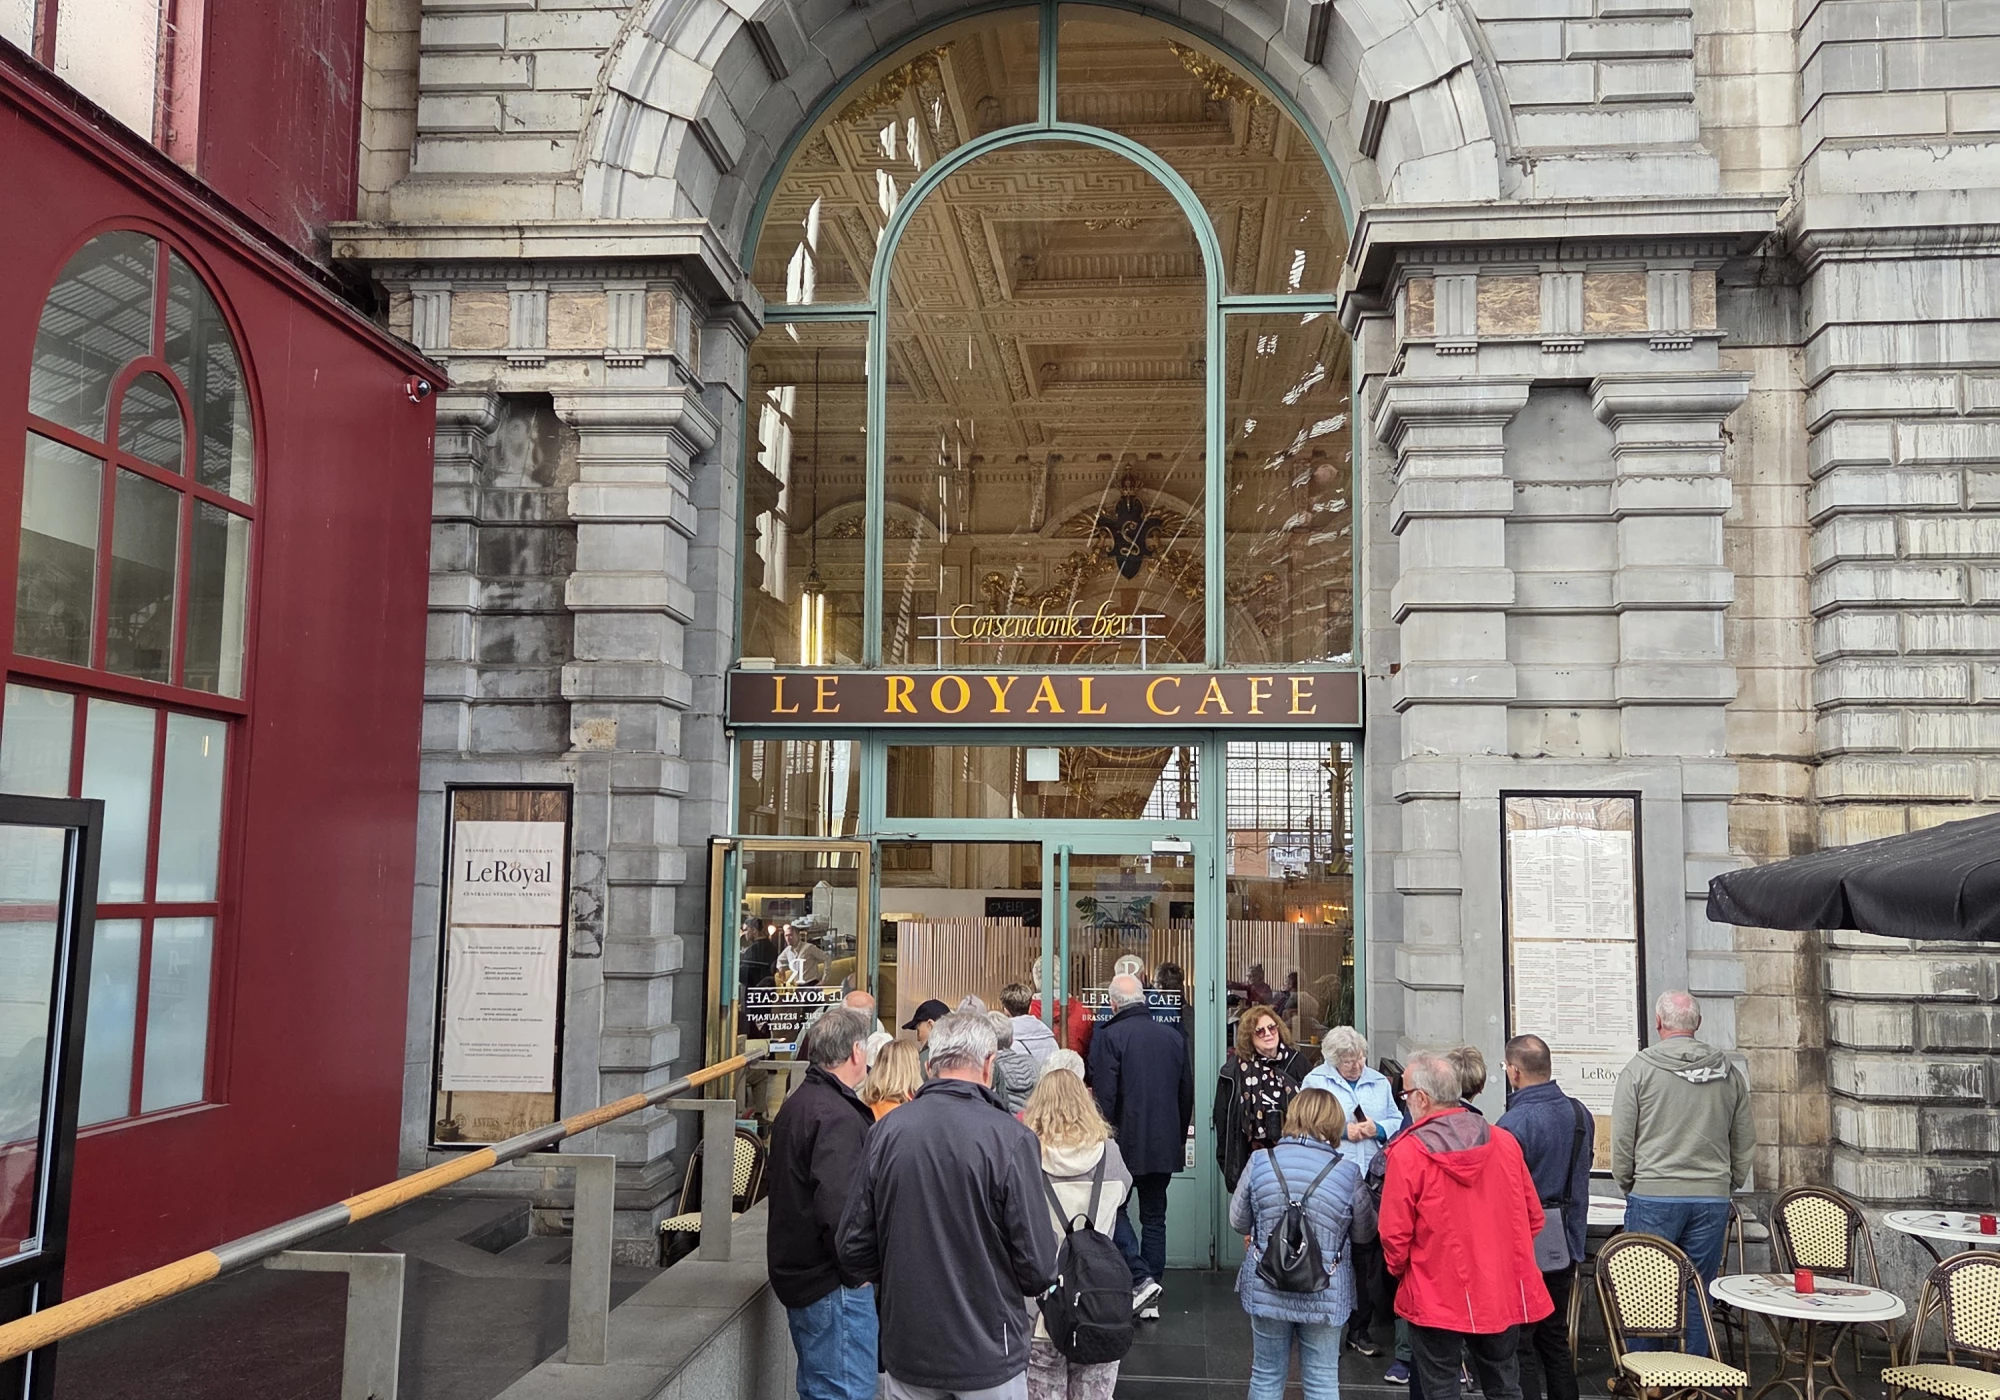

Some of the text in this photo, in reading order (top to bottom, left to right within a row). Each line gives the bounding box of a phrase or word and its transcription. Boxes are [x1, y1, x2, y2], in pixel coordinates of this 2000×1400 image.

[950, 597, 1083, 639] Corsendonk
[771, 675, 1318, 715] LE ROYAL CAFE
[1546, 808, 1597, 824] LeRoyal
[465, 860, 552, 889] LeRoyal
[1081, 993, 1097, 1004] LE
[1148, 995, 1182, 1006] CAFE
[1581, 1067, 1620, 1083] LeRoy
